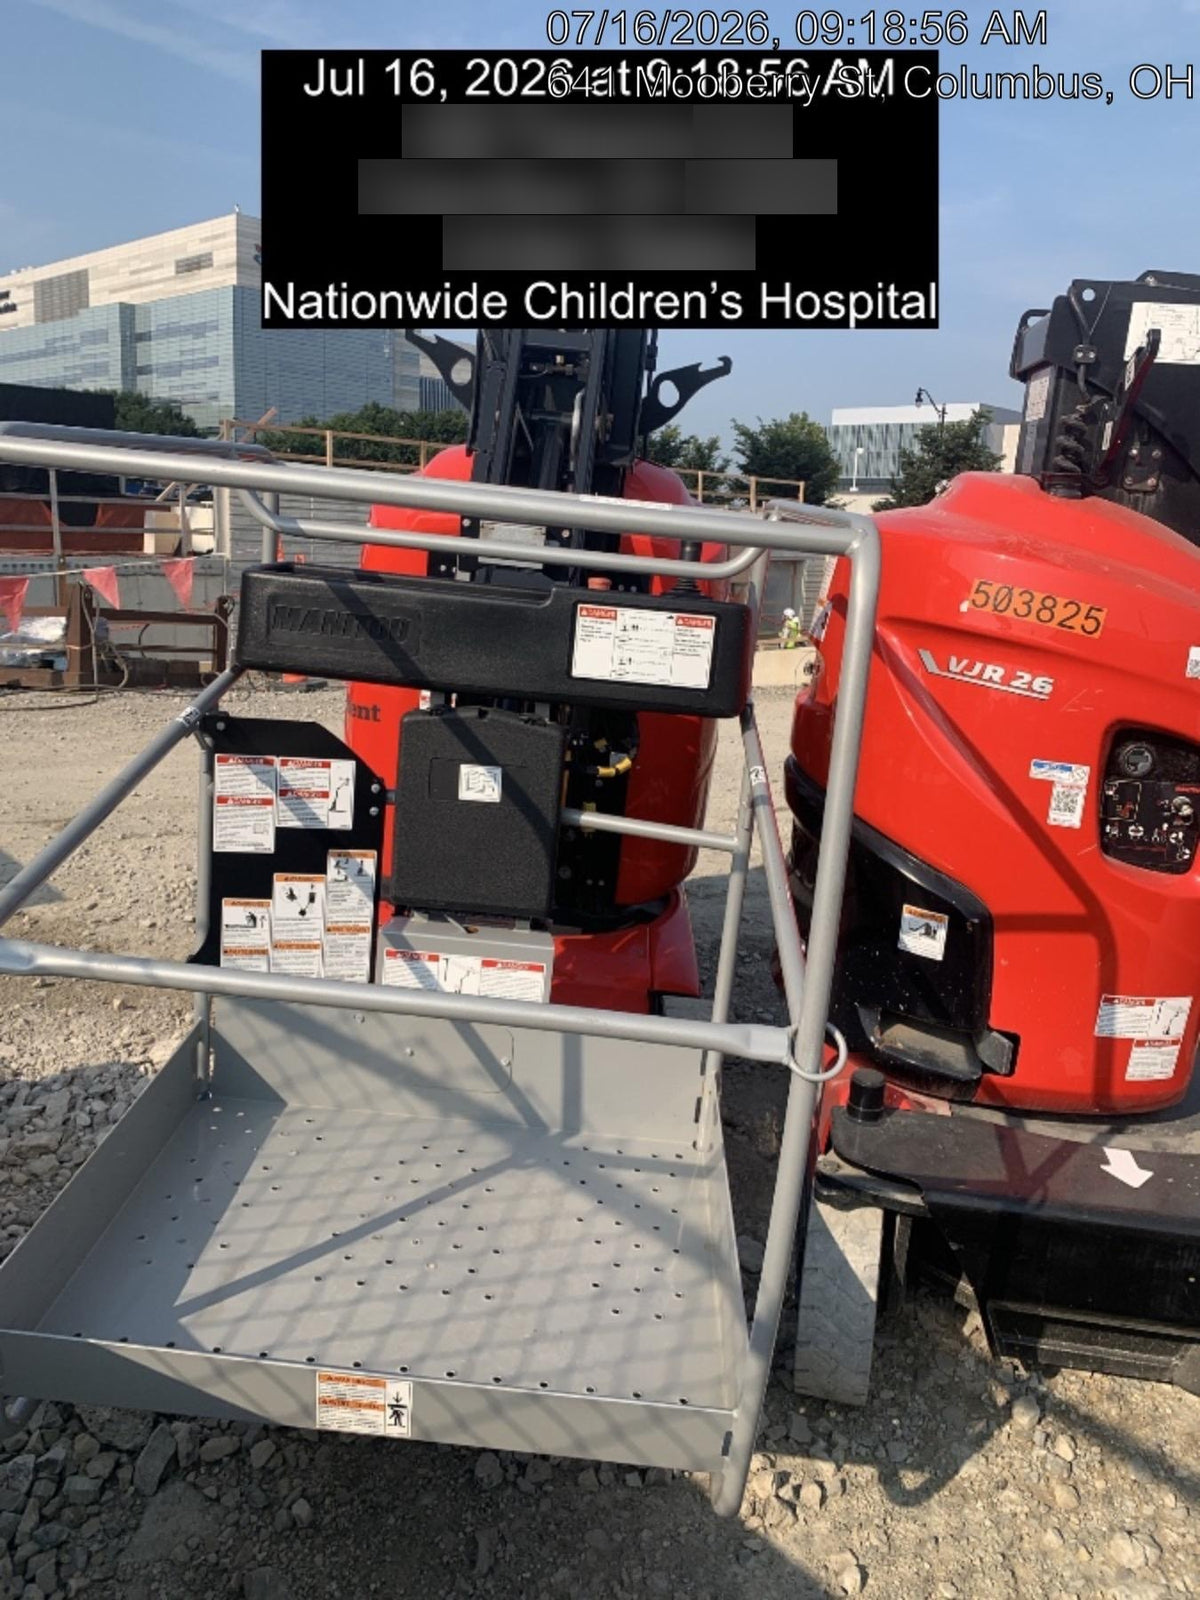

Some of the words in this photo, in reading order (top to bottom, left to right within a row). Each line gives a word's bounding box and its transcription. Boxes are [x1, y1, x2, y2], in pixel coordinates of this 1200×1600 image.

[971, 581, 1103, 635] 503825
[948, 656, 1004, 683] VJR
[1010, 670, 1054, 694] 26
